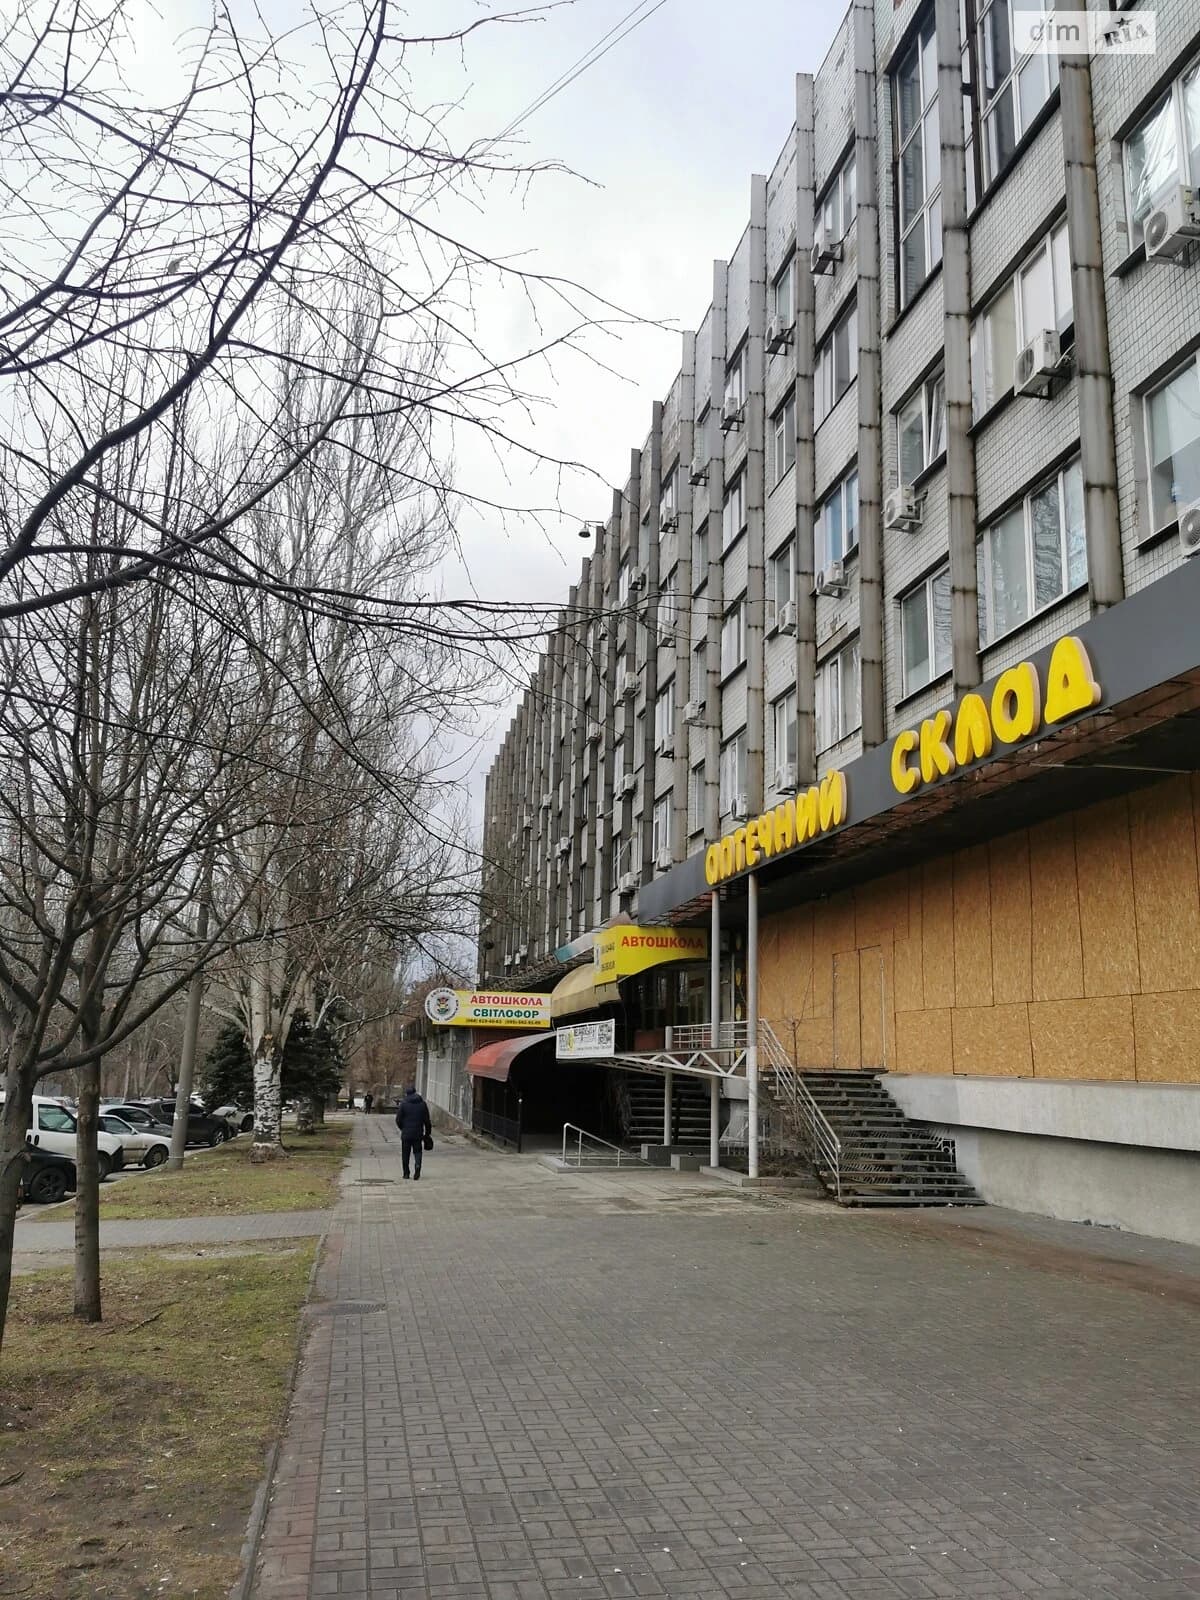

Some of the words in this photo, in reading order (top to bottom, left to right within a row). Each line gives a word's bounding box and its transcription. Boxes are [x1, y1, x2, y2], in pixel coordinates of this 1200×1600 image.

[621, 935, 705, 949] АВТОШКОЛА
[470, 995, 543, 1006] АВТОШКОЛА
[473, 1008, 540, 1018] СВІТЛОФОР
